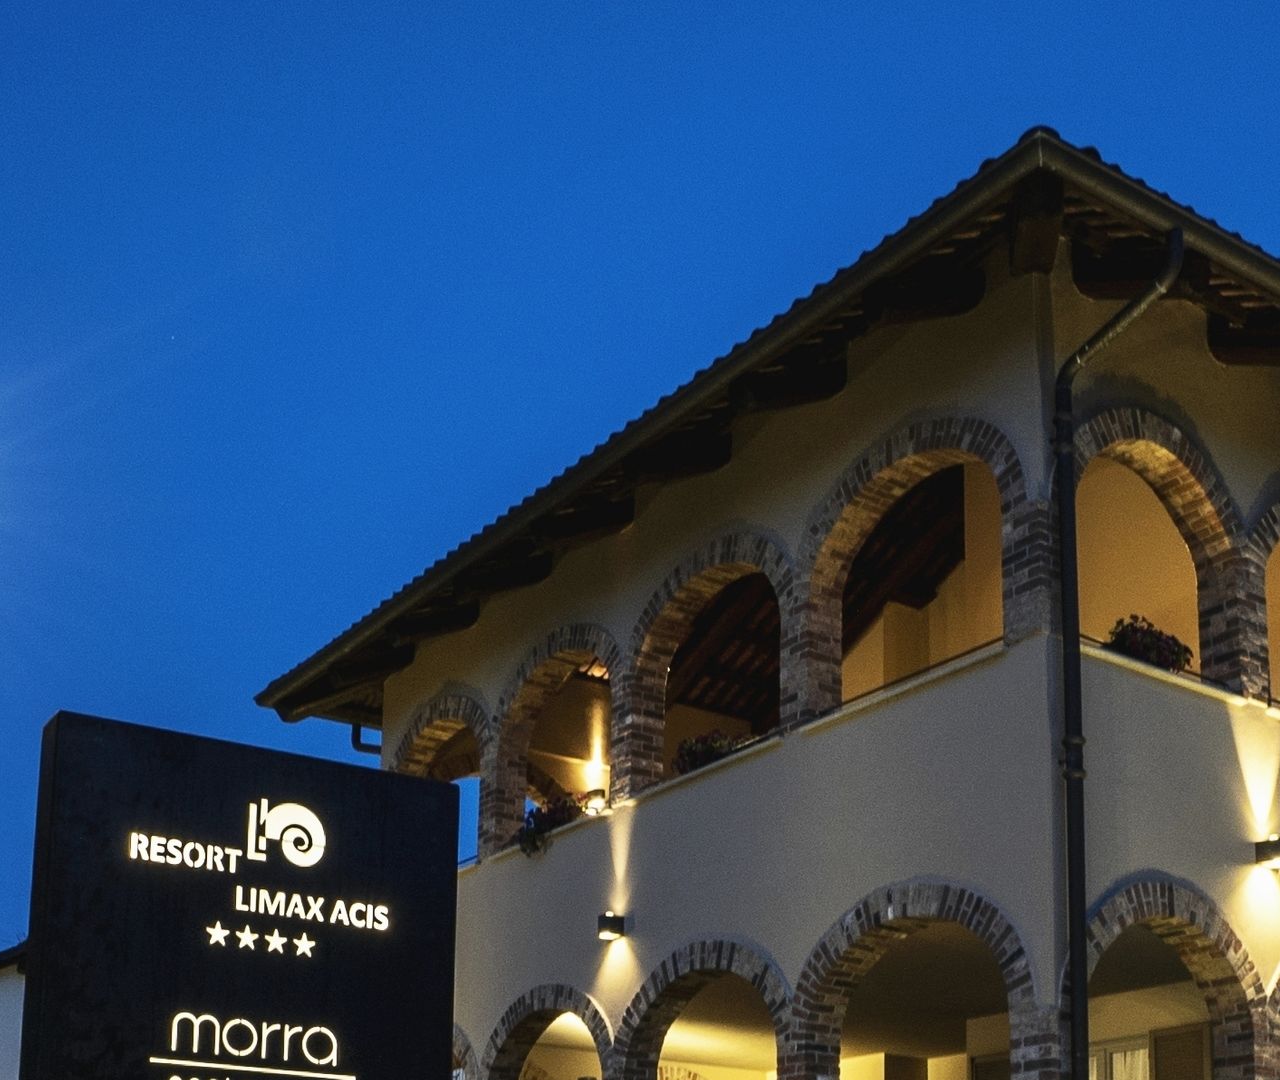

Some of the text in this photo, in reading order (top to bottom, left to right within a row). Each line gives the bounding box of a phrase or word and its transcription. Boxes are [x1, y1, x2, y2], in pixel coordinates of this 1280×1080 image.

[128, 831, 243, 874] RESORT
[234, 885, 389, 931] LIMAX ACIS
[169, 1011, 339, 1067] morra
